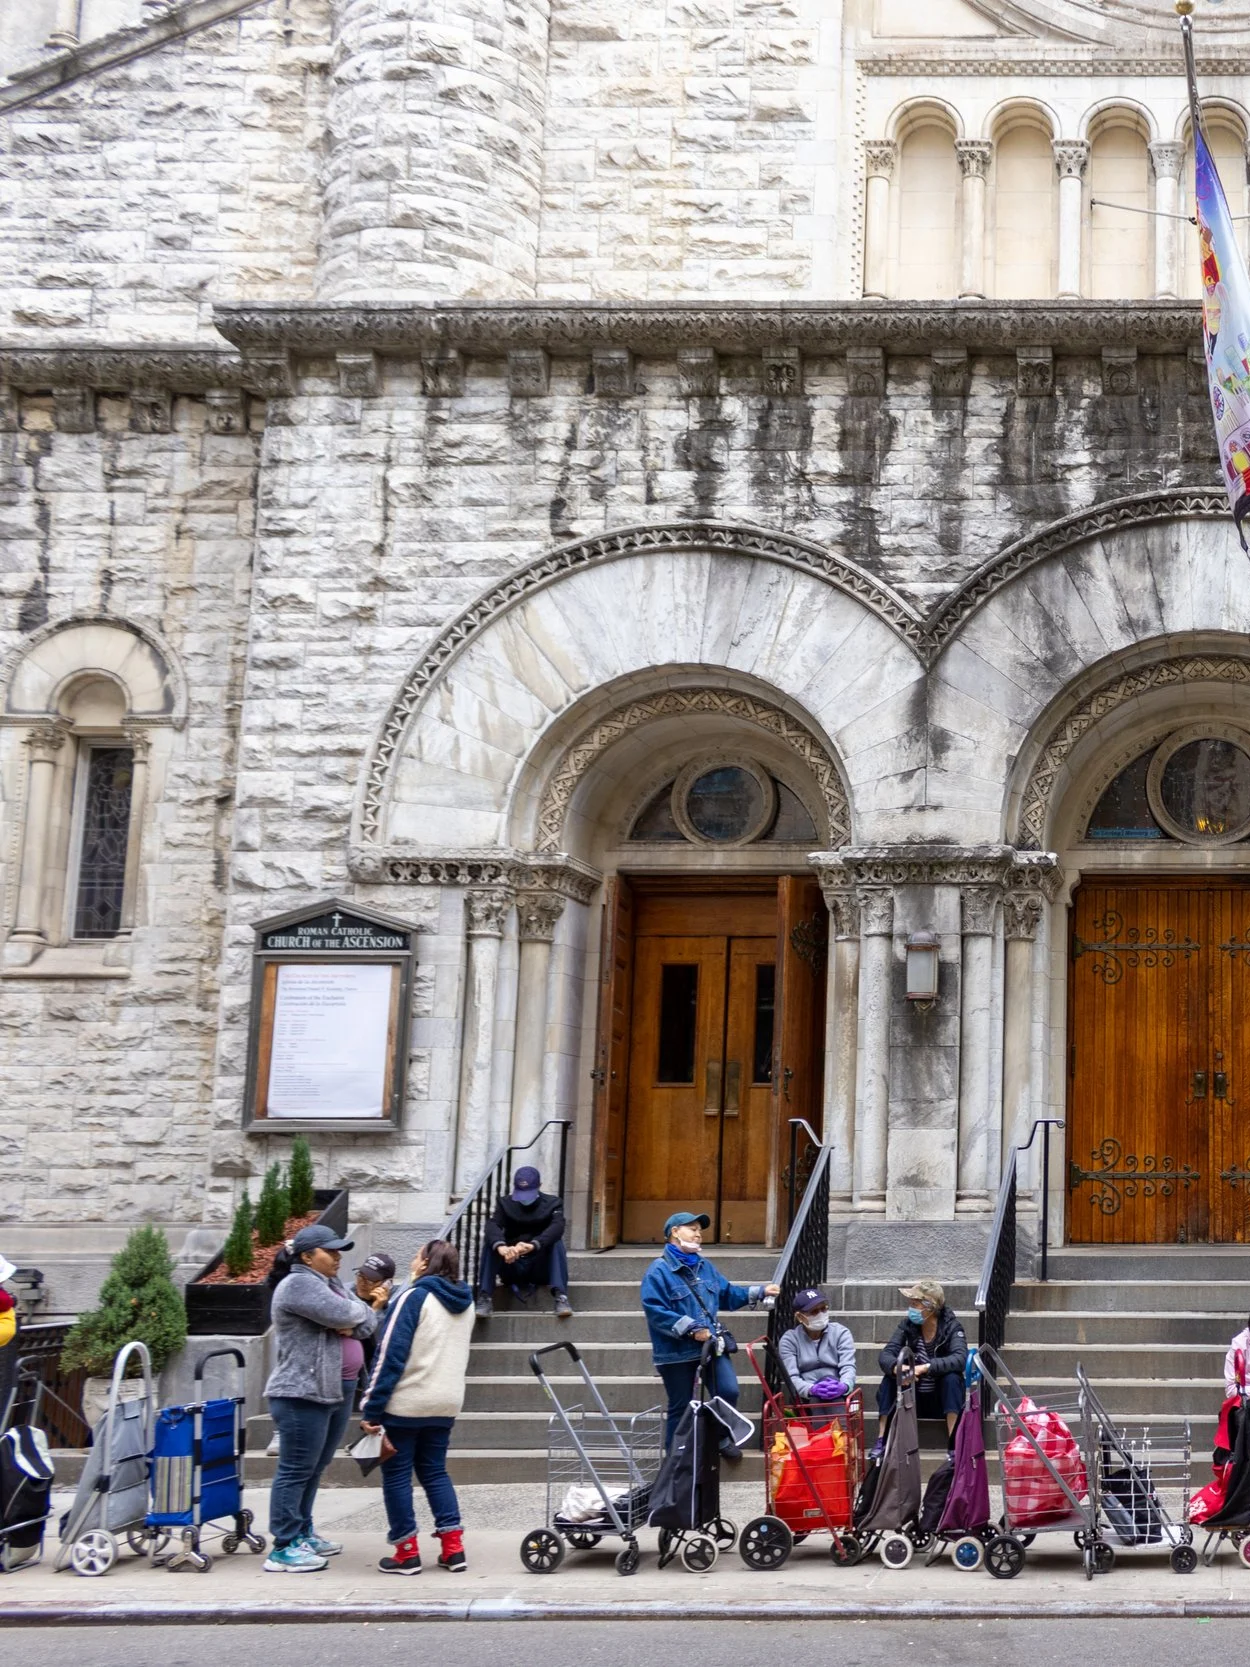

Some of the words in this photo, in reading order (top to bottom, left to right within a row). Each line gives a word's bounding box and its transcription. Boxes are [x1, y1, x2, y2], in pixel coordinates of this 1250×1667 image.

[297, 927, 328, 936] ROMAN
[331, 927, 373, 936] CATHOLIC
[267, 936, 310, 948] CHURCH
[312, 939, 322, 948] OF
[324, 939, 340, 948] THE
[342, 936, 403, 948] ASCENSION
